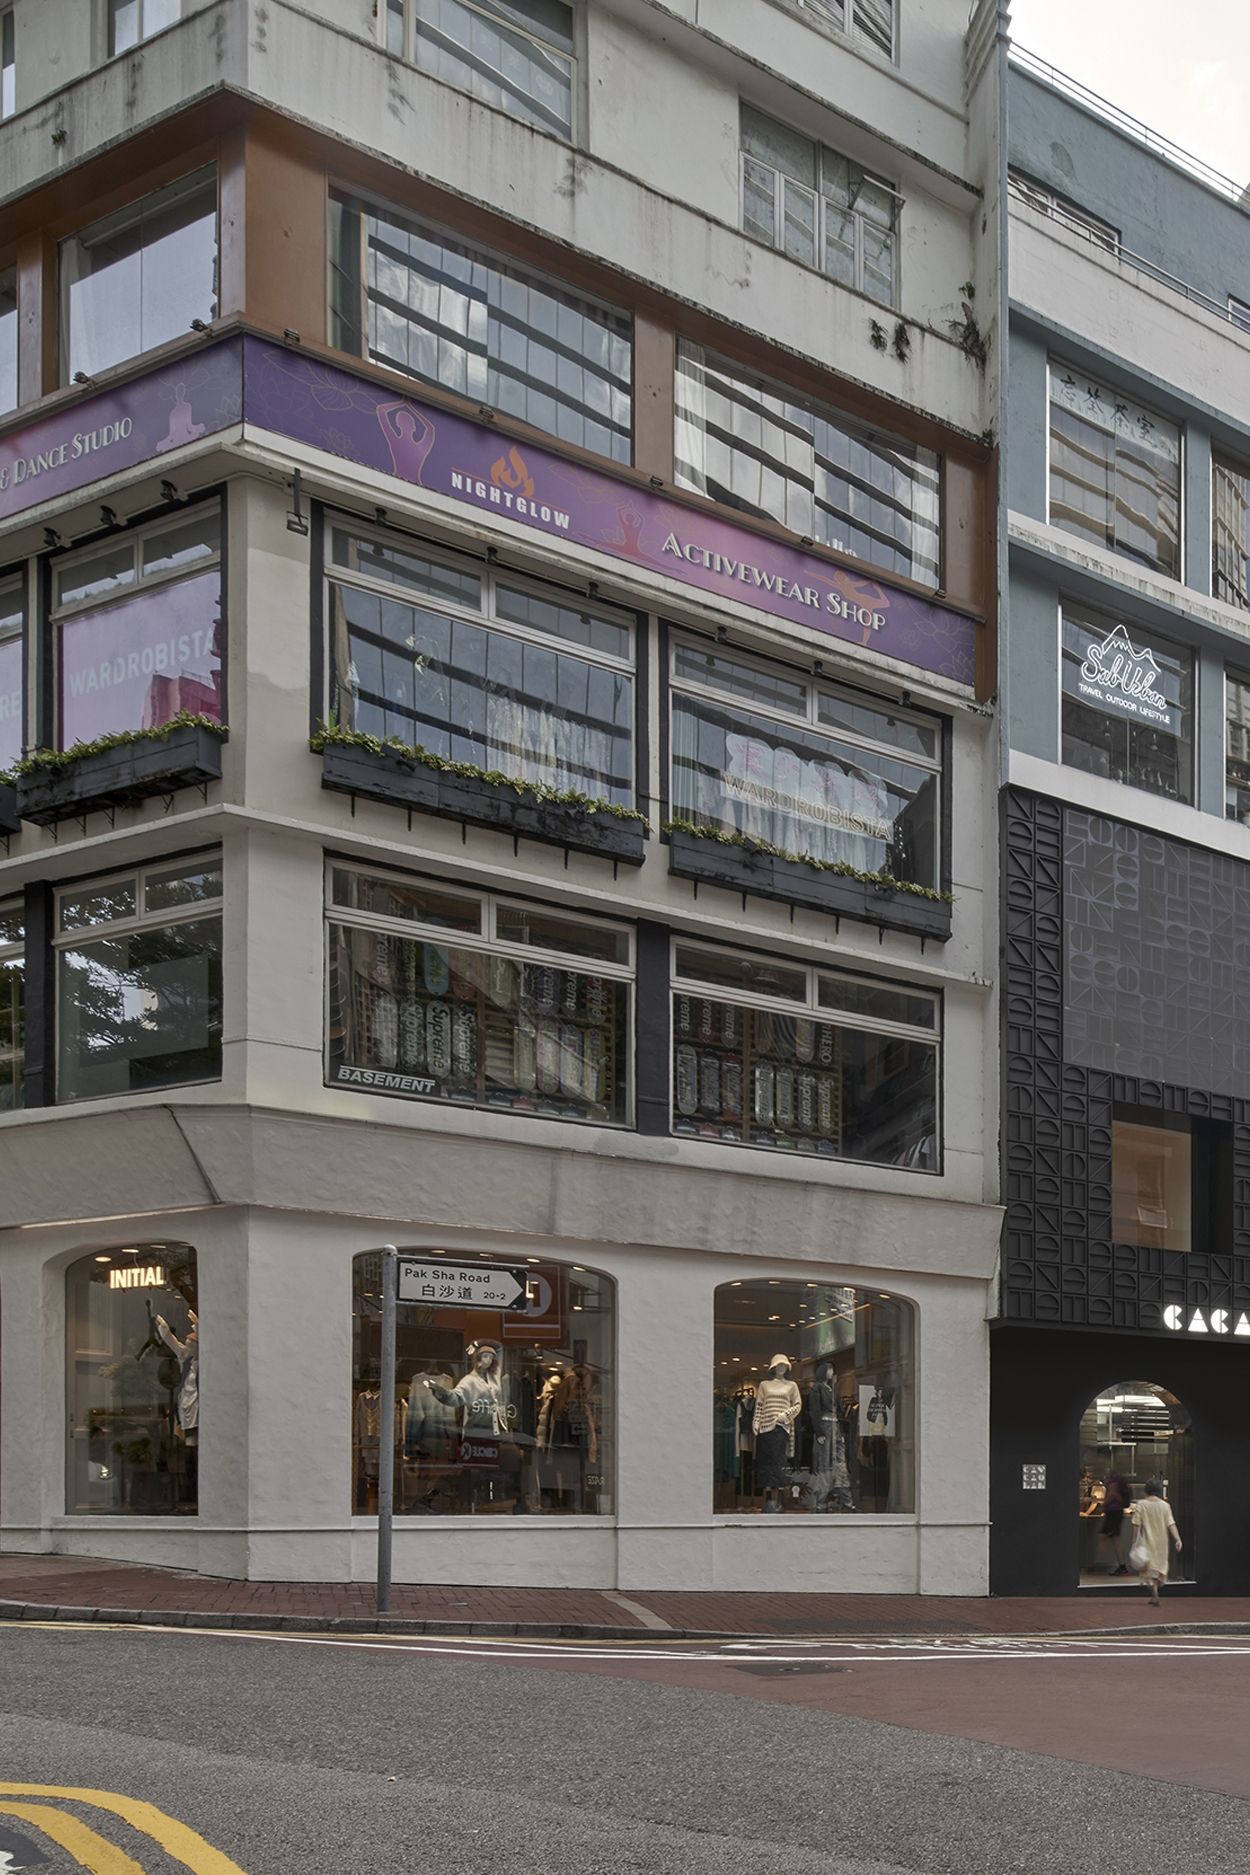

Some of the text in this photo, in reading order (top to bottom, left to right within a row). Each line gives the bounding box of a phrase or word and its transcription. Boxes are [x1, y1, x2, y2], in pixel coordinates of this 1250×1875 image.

[14, 443, 69, 486] DANCE
[71, 417, 133, 459] STUDIO
[451, 471, 570, 530] NIGHTGLOW
[661, 532, 887, 630] ACTIVEWEAR SHOP
[69, 627, 216, 699] WARDROBISTA
[1078, 683, 1171, 724] TRAVEL OUTDOOR LIFESTYLE
[722, 773, 892, 840] WARDROBISTA
[428, 1007, 449, 1069] Supreme
[455, 1012, 475, 1073] Supreme
[337, 1066, 436, 1093] BASEMENT
[110, 1266, 164, 1289] INITIAL
[404, 1267, 491, 1284] Pak Sha Road
[421, 1284, 473, 1300] 白沙道
[483, 1291, 506, 1300] 20-2
